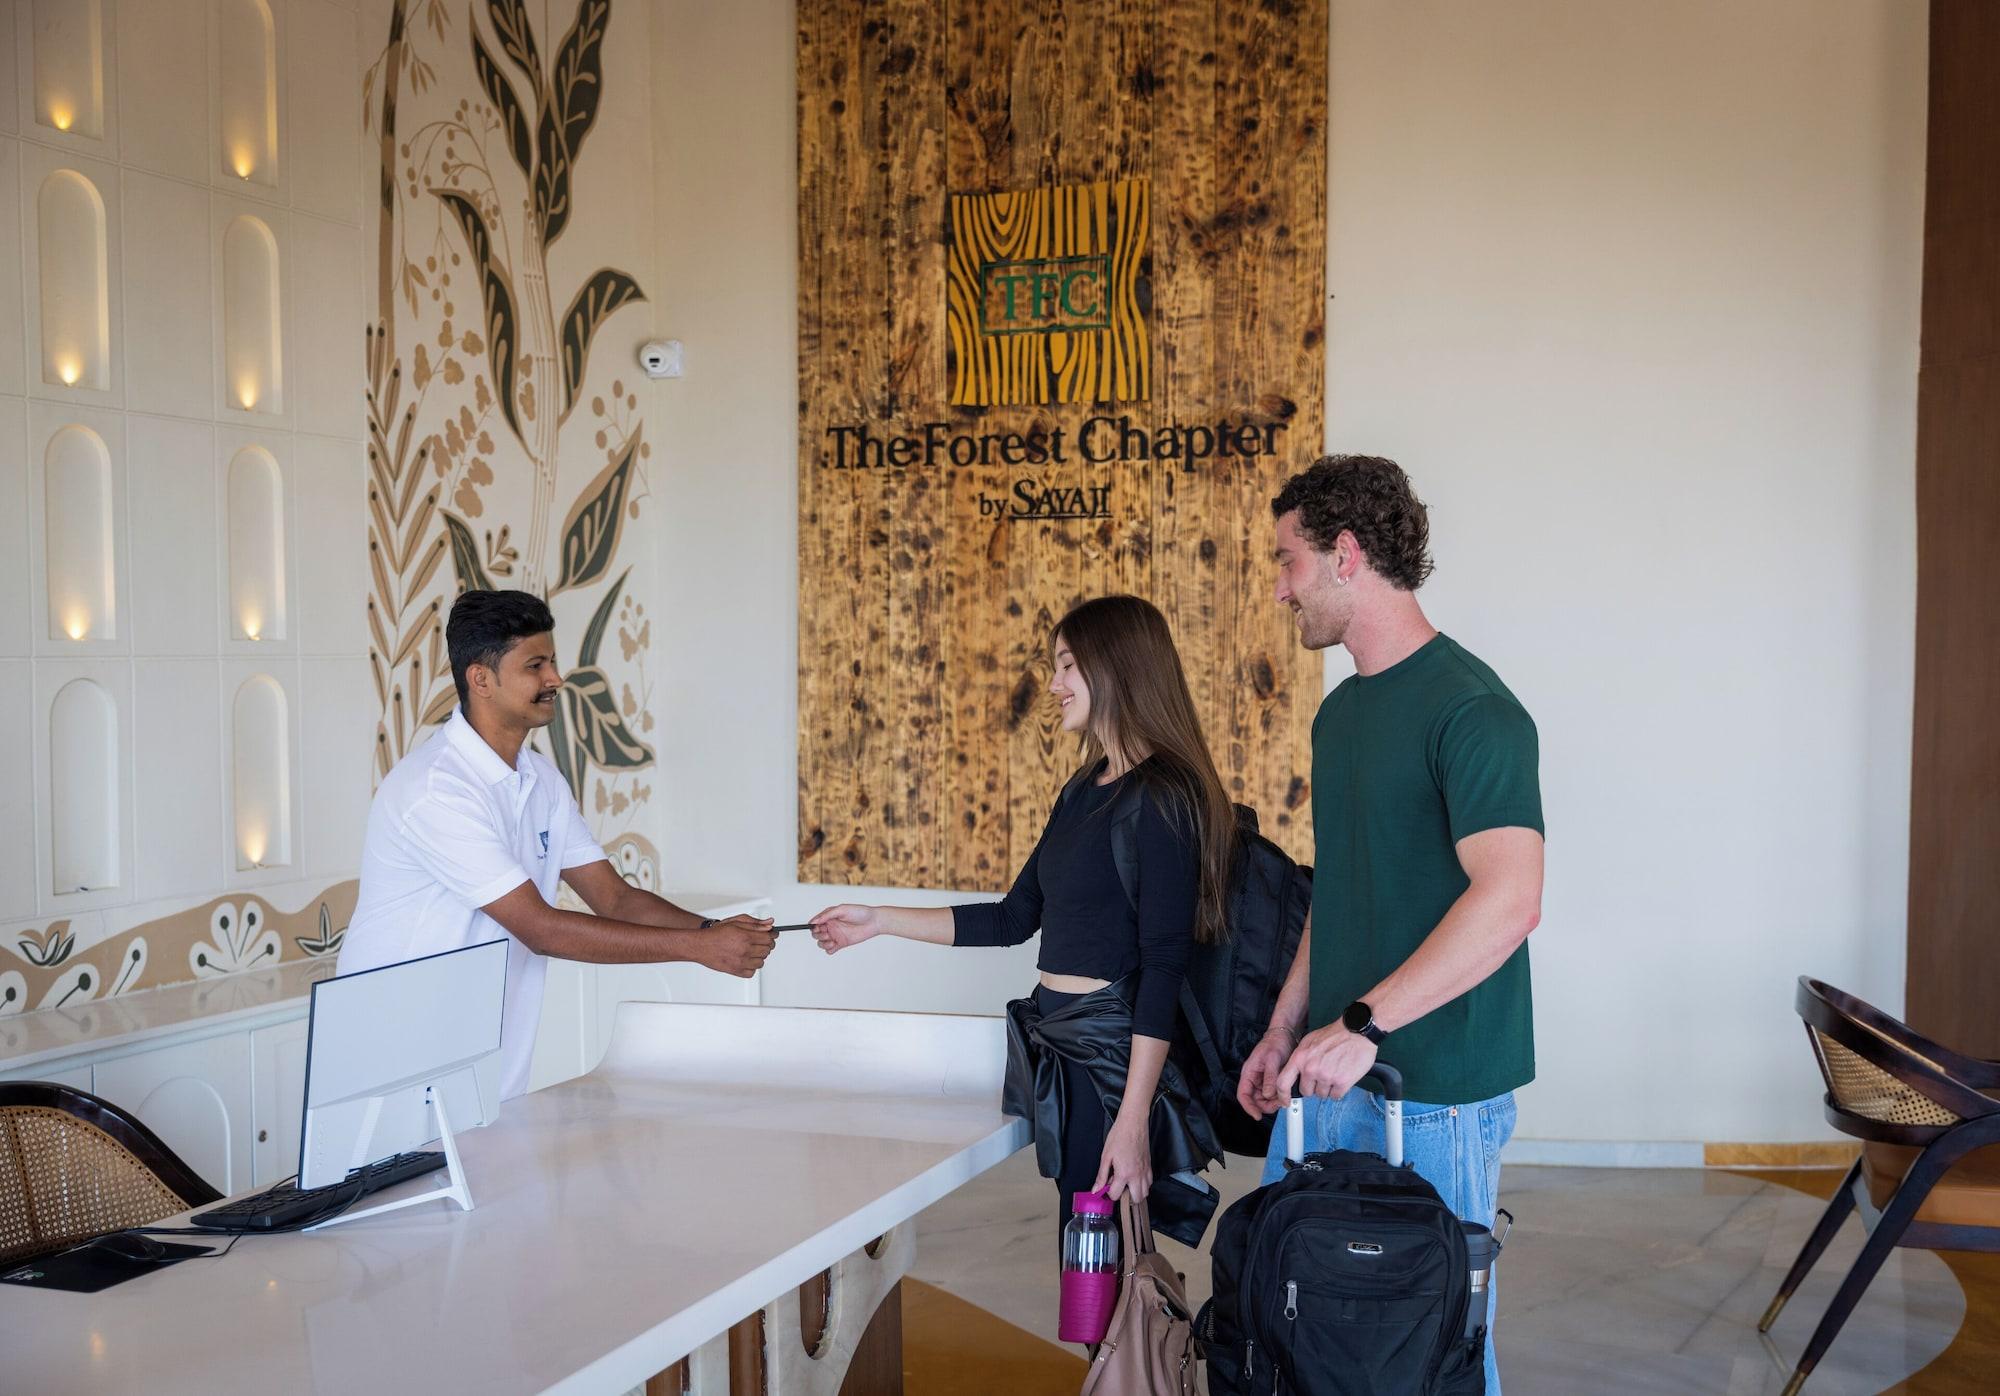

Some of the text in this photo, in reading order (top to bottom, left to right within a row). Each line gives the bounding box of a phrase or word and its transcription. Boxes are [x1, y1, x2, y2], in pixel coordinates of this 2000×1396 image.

[994, 269, 1098, 320] TFC
[826, 415, 1289, 473] The Forest Chapter
[978, 478, 1111, 521] by SAYAJI
